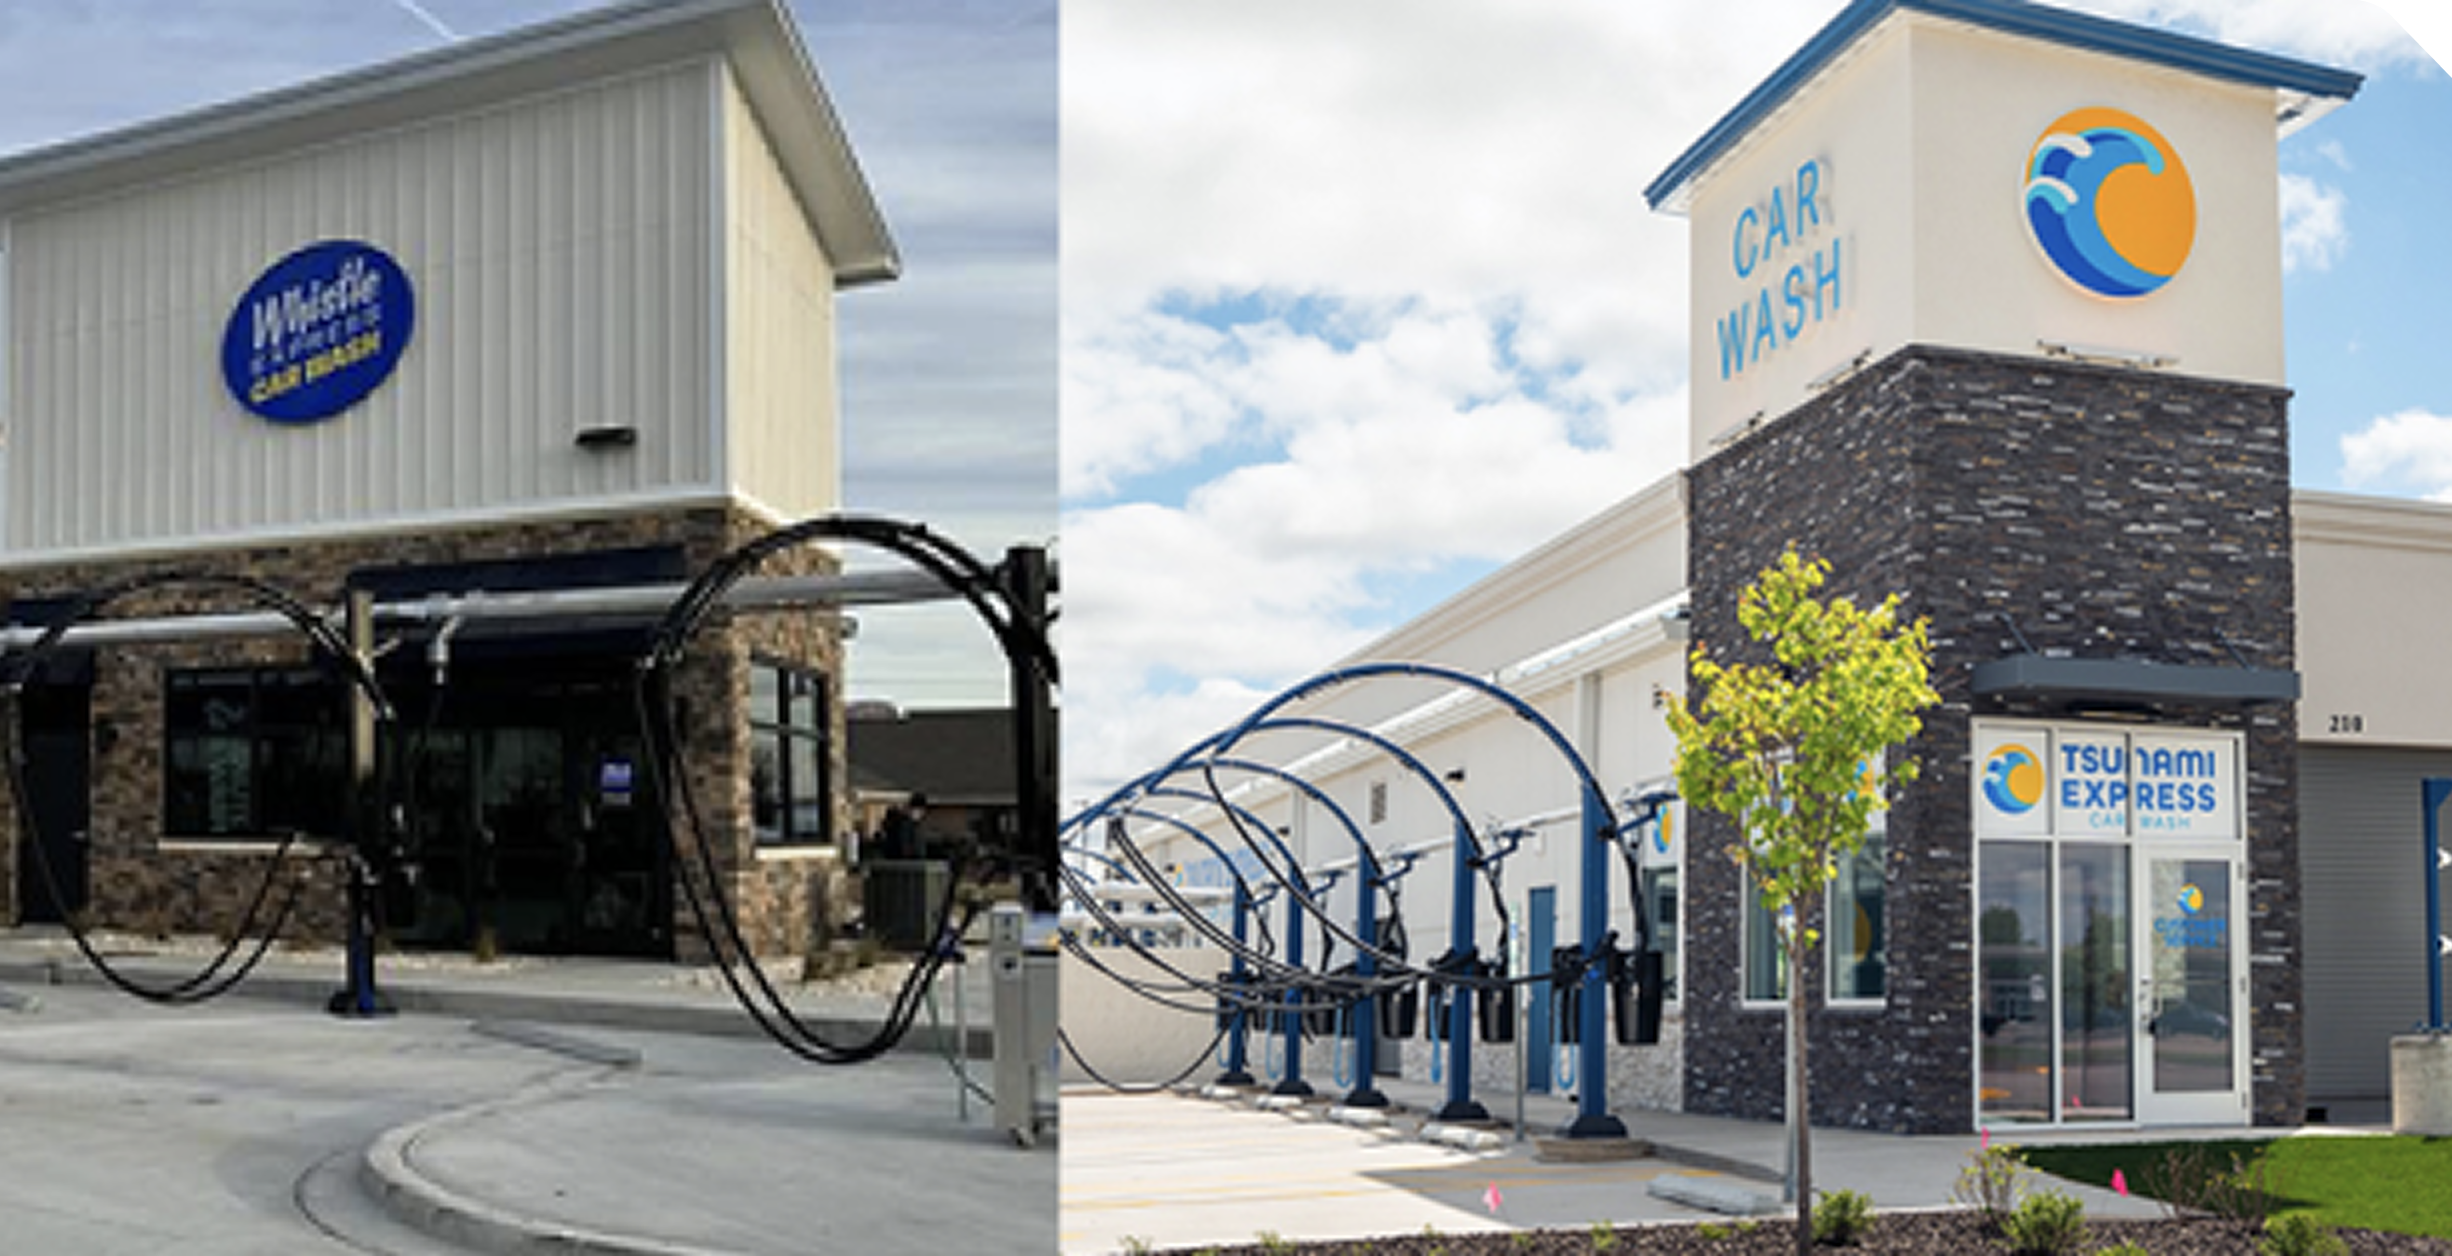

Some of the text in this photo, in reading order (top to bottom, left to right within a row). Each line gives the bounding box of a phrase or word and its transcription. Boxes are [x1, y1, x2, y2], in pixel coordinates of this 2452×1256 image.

[1732, 159, 1820, 279] CAR
[252, 256, 379, 349] Whistle
[1716, 236, 1841, 381] WASH
[250, 364, 302, 402] CAR
[305, 331, 380, 384] WASH
[2060, 743, 2216, 780] TSUNAMI
[2060, 778, 2217, 813] EXPRESS
[2089, 810, 2192, 831] CAR WASH
